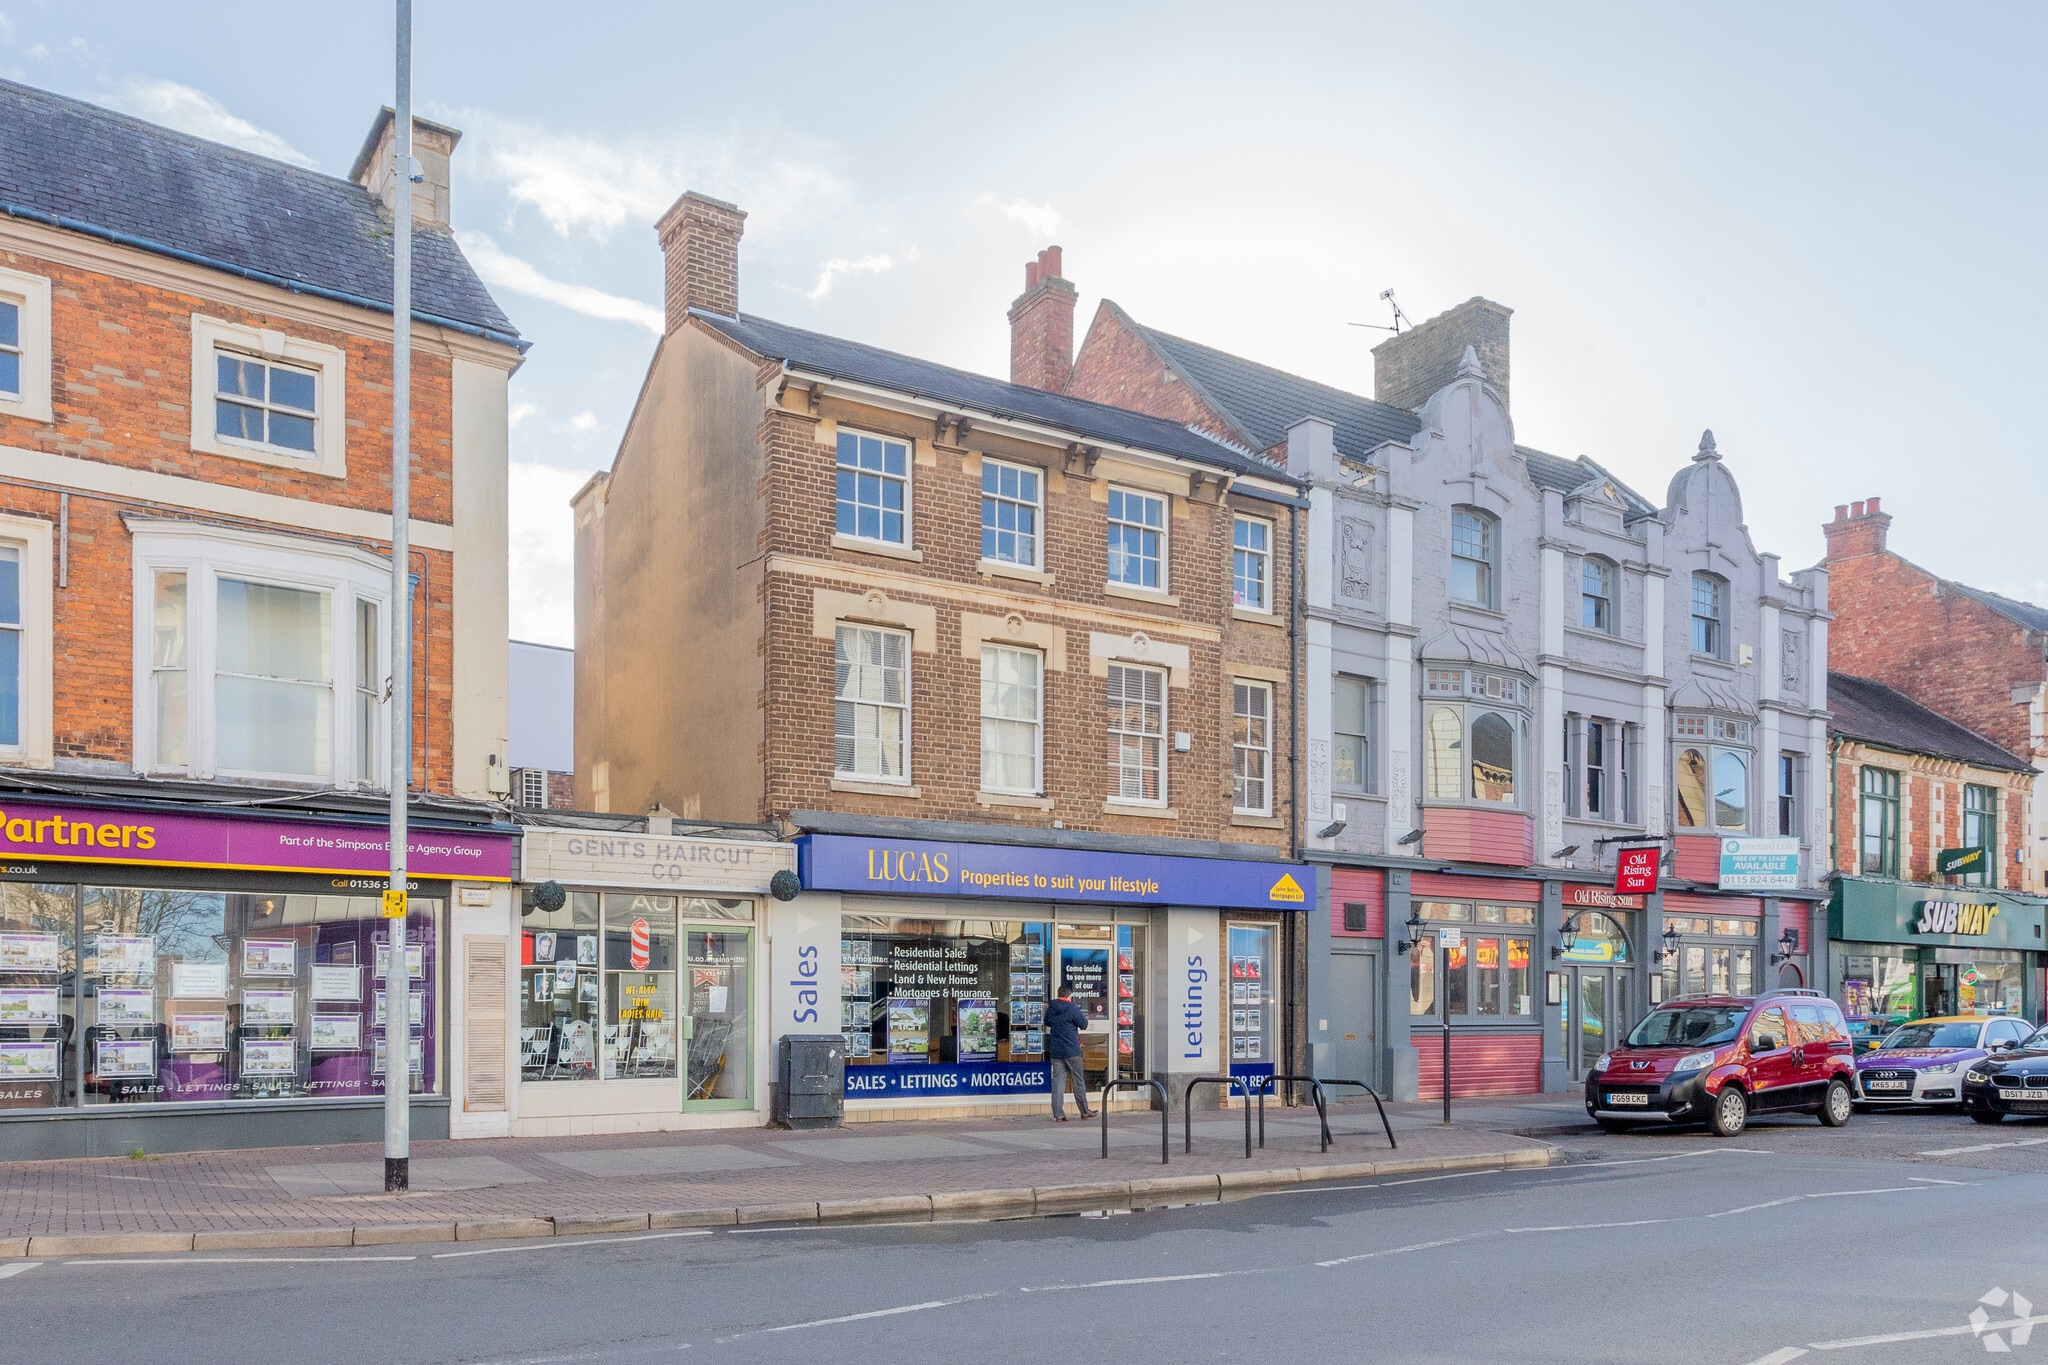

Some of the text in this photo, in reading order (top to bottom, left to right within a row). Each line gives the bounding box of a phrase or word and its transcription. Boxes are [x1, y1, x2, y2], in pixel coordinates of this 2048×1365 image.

[0, 810, 156, 849] artners
[280, 835, 301, 846] Part
[303, 837, 315, 847] of
[316, 837, 334, 848] the
[335, 838, 383, 851] Simpsons
[416, 845, 452, 857] Agency
[453, 846, 482, 858] Group
[1777, 840, 1796, 850] cole
[567, 838, 754, 865] GENTS HAIRCUT
[1629, 854, 1647, 865] Old
[1945, 850, 1982, 871] SUBWAY
[1623, 865, 1651, 876] Rising
[1734, 862, 1786, 870] AVAILABLE
[651, 863, 683, 882] CO
[867, 849, 1159, 896] LUCAS Properties to suit your lifestyle
[332, 879, 348, 888] Call
[350, 880, 381, 889] 01536
[1627, 878, 1645, 887] Sun
[1724, 876, 1794, 884] 0115 824 6442
[1574, 889, 1633, 908] Old Rising Sun
[1917, 901, 1999, 935] SUBWAY
[894, 947, 943, 958] Residential
[944, 948, 967, 959] Sales
[894, 960, 943, 971] Residential
[944, 962, 978, 973] Lettings
[1066, 965, 1102, 973] Come inside
[790, 945, 818, 1023] Sales
[894, 974, 978, 985] Land & New Homes
[625, 984, 657, 995] WE ALSO
[894, 987, 992, 999] Mortgages & Insurance
[1183, 955, 1208, 1058] Lettings
[619, 1009, 663, 1019] LADIES HAIR
[121, 1085, 164, 1094] SALES
[177, 1083, 241, 1092] LETTINGS
[252, 1082, 292, 1090] SALES
[302, 1080, 361, 1089] LETTINGS
[847, 1071, 1044, 1091] SALES LETTINGS MORTGAGES
[1871, 1081, 1905, 1089] AK65 JJE
[1612, 1095, 1647, 1103] FG59 CKC
[2025, 1091, 2043, 1099] JZD
